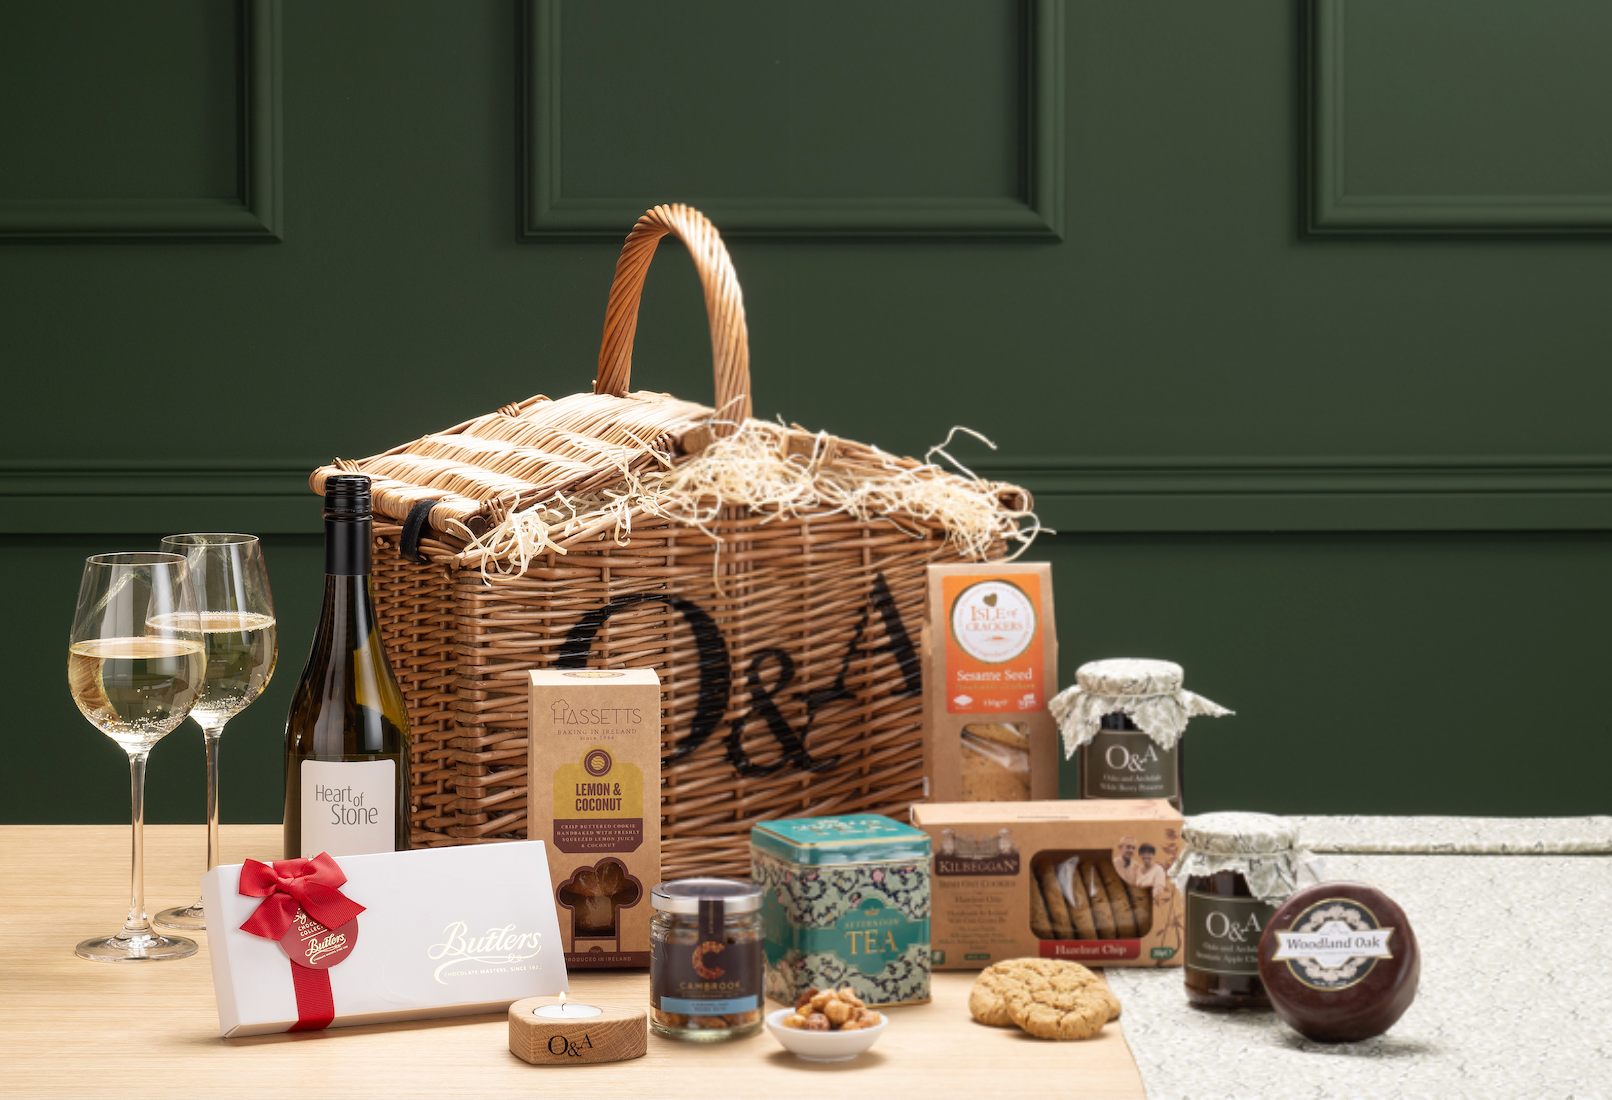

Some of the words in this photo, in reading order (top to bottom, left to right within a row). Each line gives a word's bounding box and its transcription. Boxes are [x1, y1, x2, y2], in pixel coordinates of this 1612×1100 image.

[957, 669, 1002, 682] Sesame
[1004, 667, 1033, 681] Seed
[551, 705, 642, 725] HASSETTS
[1105, 744, 1159, 773] O&A
[315, 784, 352, 802] Heart
[353, 792, 364, 807] of
[576, 783, 611, 796] LEMON
[613, 782, 622, 796] &
[575, 798, 622, 811] COCONUT
[331, 803, 378, 825] Stone
[938, 859, 1016, 873] KILBEGGAN
[844, 918, 899, 929] AFTERNOON
[1206, 911, 1262, 942] O&A
[305, 933, 347, 957] Butlers
[428, 920, 542, 960] Butlers
[844, 928, 899, 955] TEA
[1286, 937, 1352, 950] Woodland
[1354, 935, 1380, 949] Oak
[1055, 945, 1100, 955] Hazelnut
[1101, 943, 1127, 955] Chip
[443, 969, 479, 978] CHOCOLATE
[679, 981, 741, 991] CAMBROOK
[548, 1034, 594, 1058] O&A
